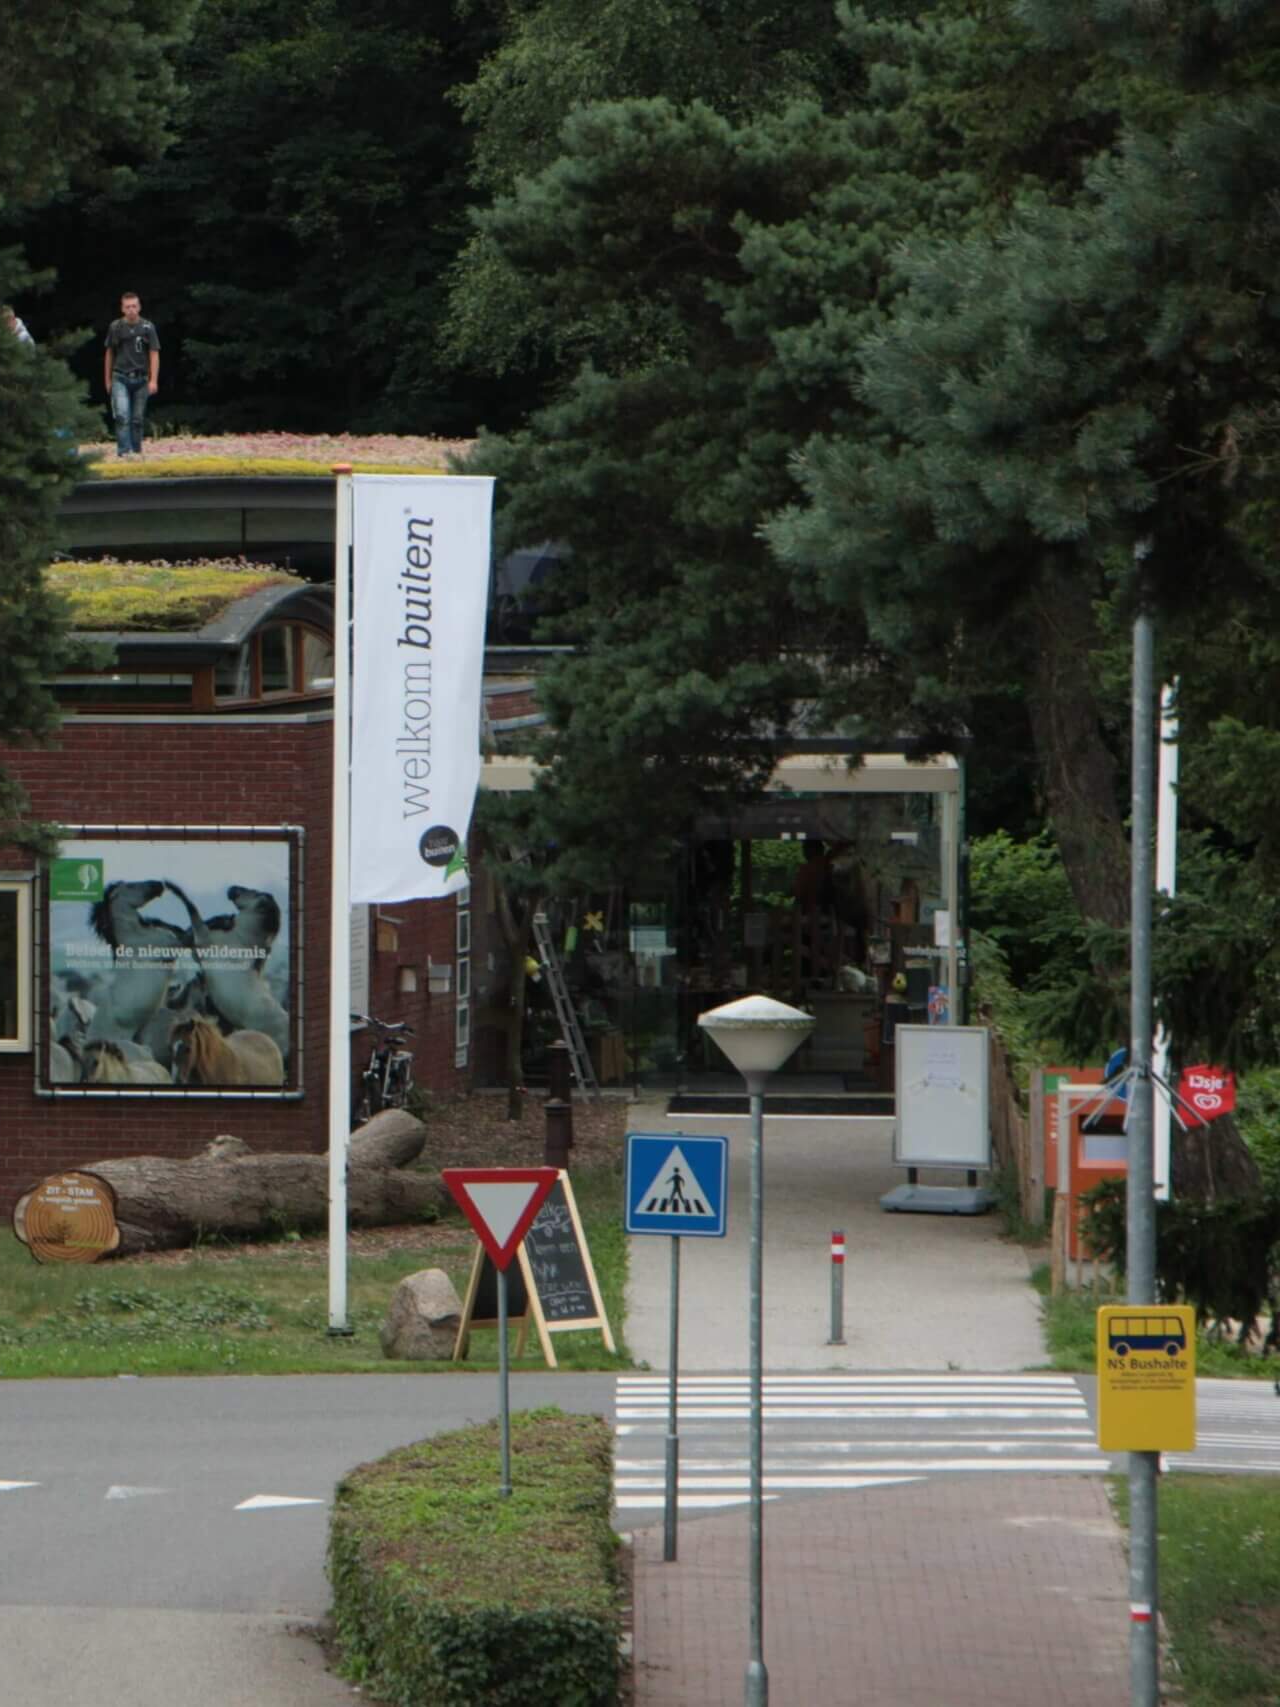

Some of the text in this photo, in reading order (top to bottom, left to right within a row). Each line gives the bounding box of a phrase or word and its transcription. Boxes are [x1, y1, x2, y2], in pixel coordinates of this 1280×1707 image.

[395, 660, 432, 820] welkom
[115, 944, 134, 957] de
[138, 944, 193, 957] nieuwe
[1108, 1358, 1187, 1370] NS Bushalte
